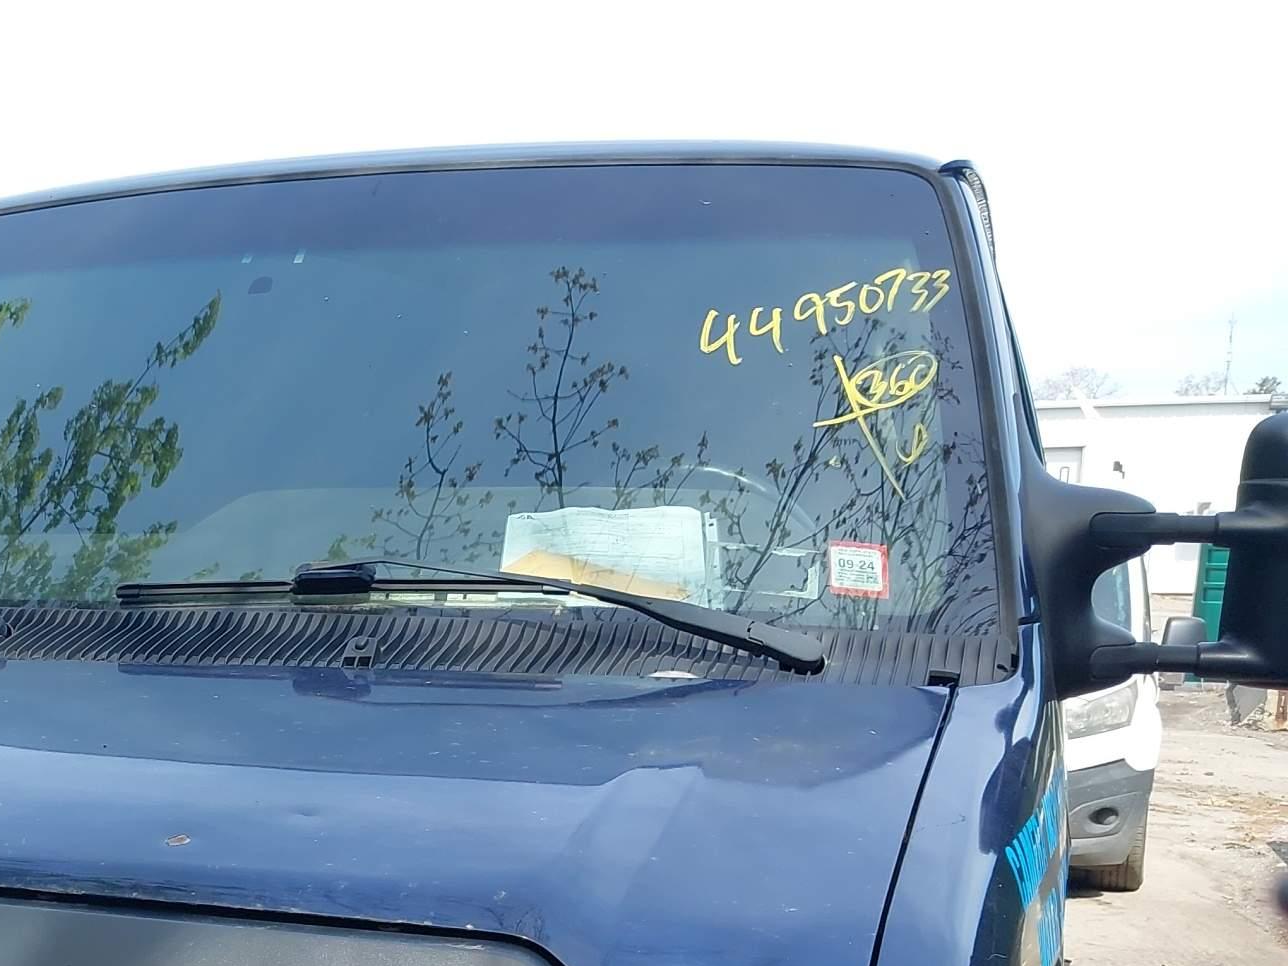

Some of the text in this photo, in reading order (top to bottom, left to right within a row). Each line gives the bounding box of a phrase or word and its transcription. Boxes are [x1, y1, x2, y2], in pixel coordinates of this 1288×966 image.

[699, 268, 951, 365] 44950733
[838, 558, 875, 571] 09 24
